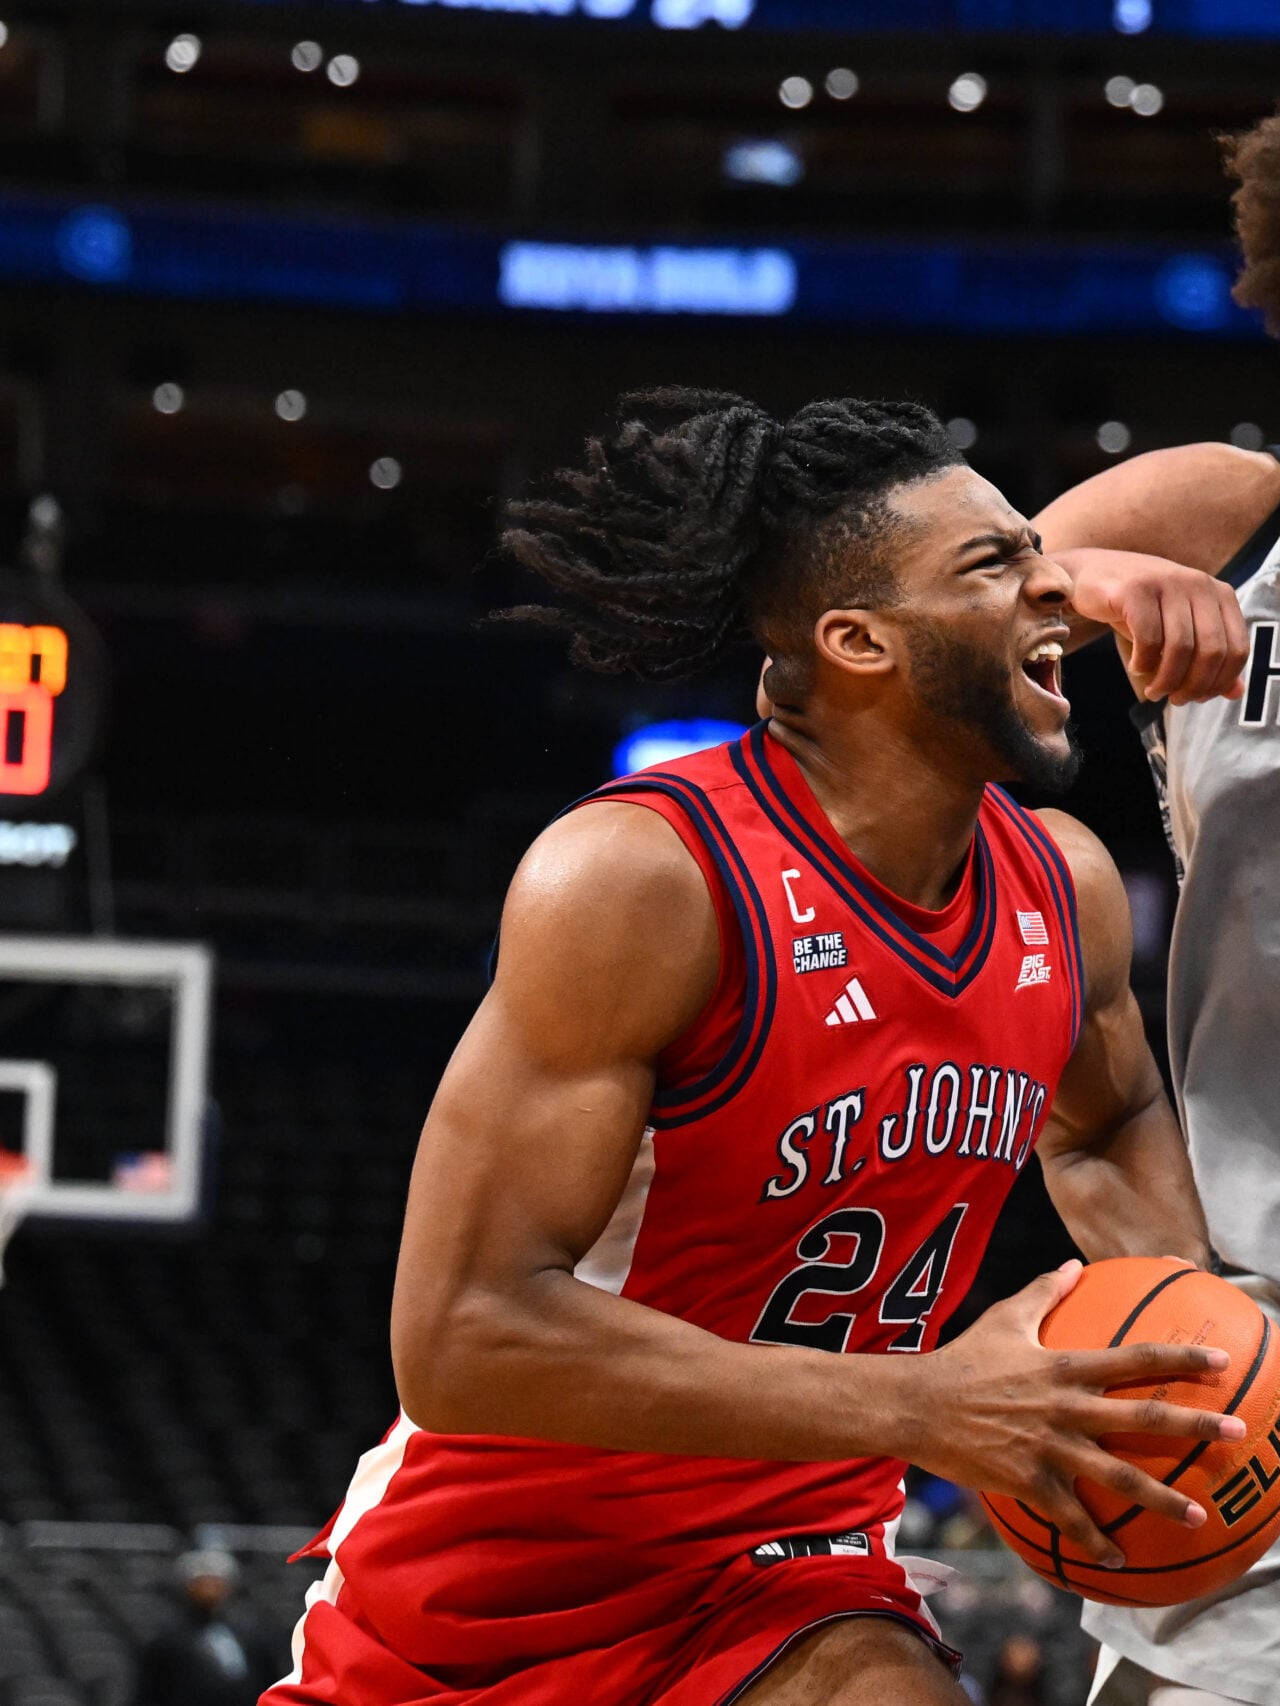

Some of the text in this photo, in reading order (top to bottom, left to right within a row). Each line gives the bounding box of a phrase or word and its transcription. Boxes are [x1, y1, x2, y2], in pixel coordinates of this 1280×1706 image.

[781, 868, 816, 923] C
[793, 933, 842, 957] BE THE
[793, 949, 847, 974] CHANGE
[1021, 953, 1045, 971] BIG
[1017, 965, 1052, 984] EAST
[758, 1061, 1048, 1204] ST. JOHN'S
[749, 1203, 969, 1353] 24
